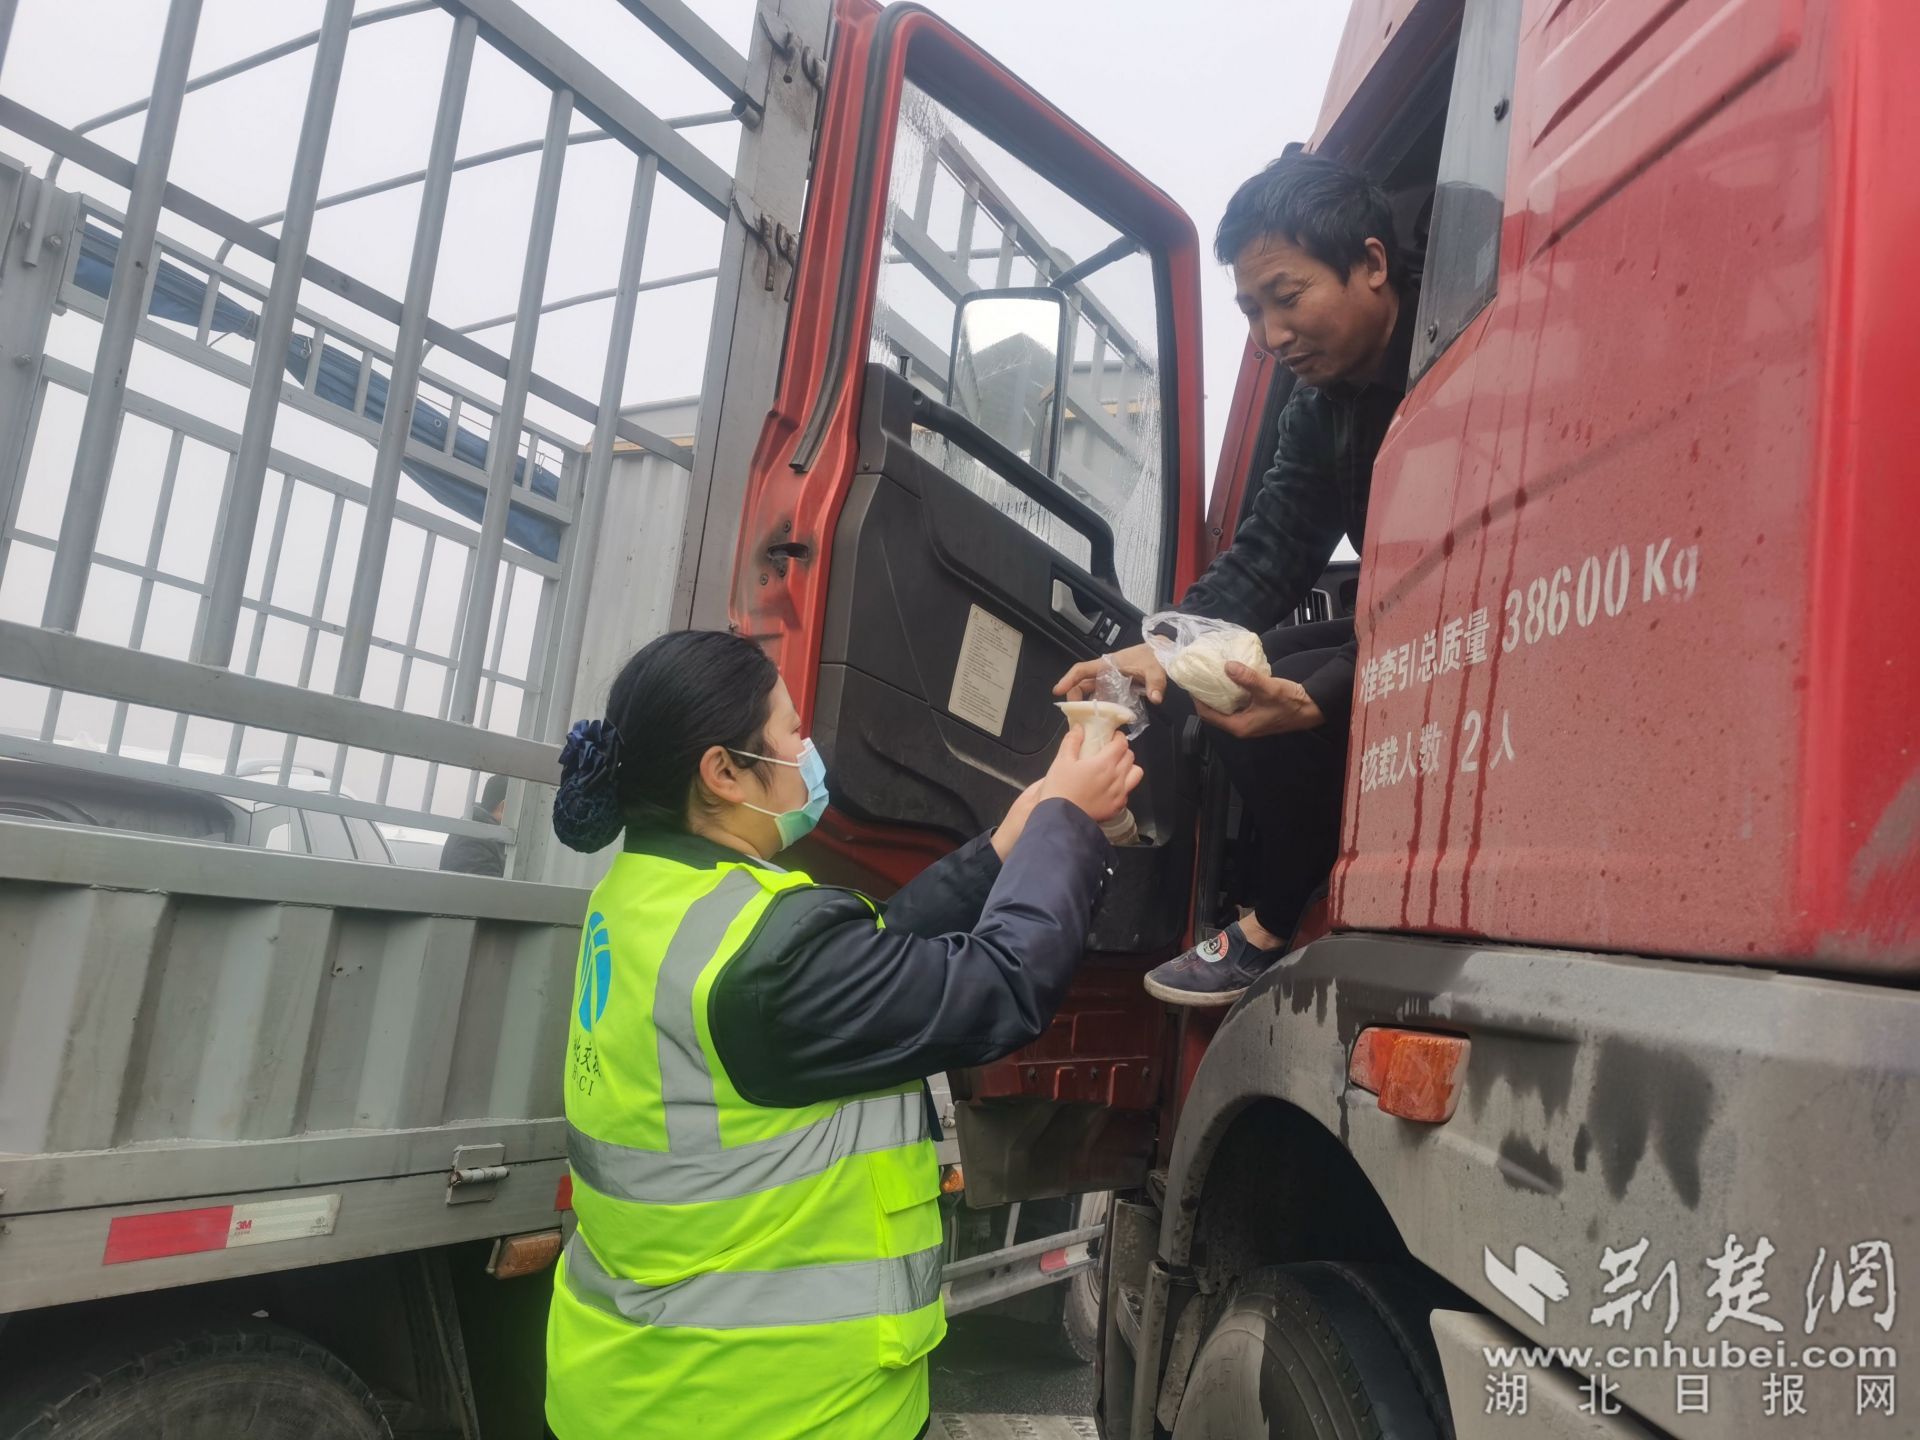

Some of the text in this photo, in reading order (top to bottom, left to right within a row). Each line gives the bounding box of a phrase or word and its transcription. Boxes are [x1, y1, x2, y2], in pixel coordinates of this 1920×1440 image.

[1359, 537, 1699, 704] 准牵引总质量 38600 Kg
[1360, 721, 1443, 793] 核载人数
[235, 1219, 253, 1231] 3M
